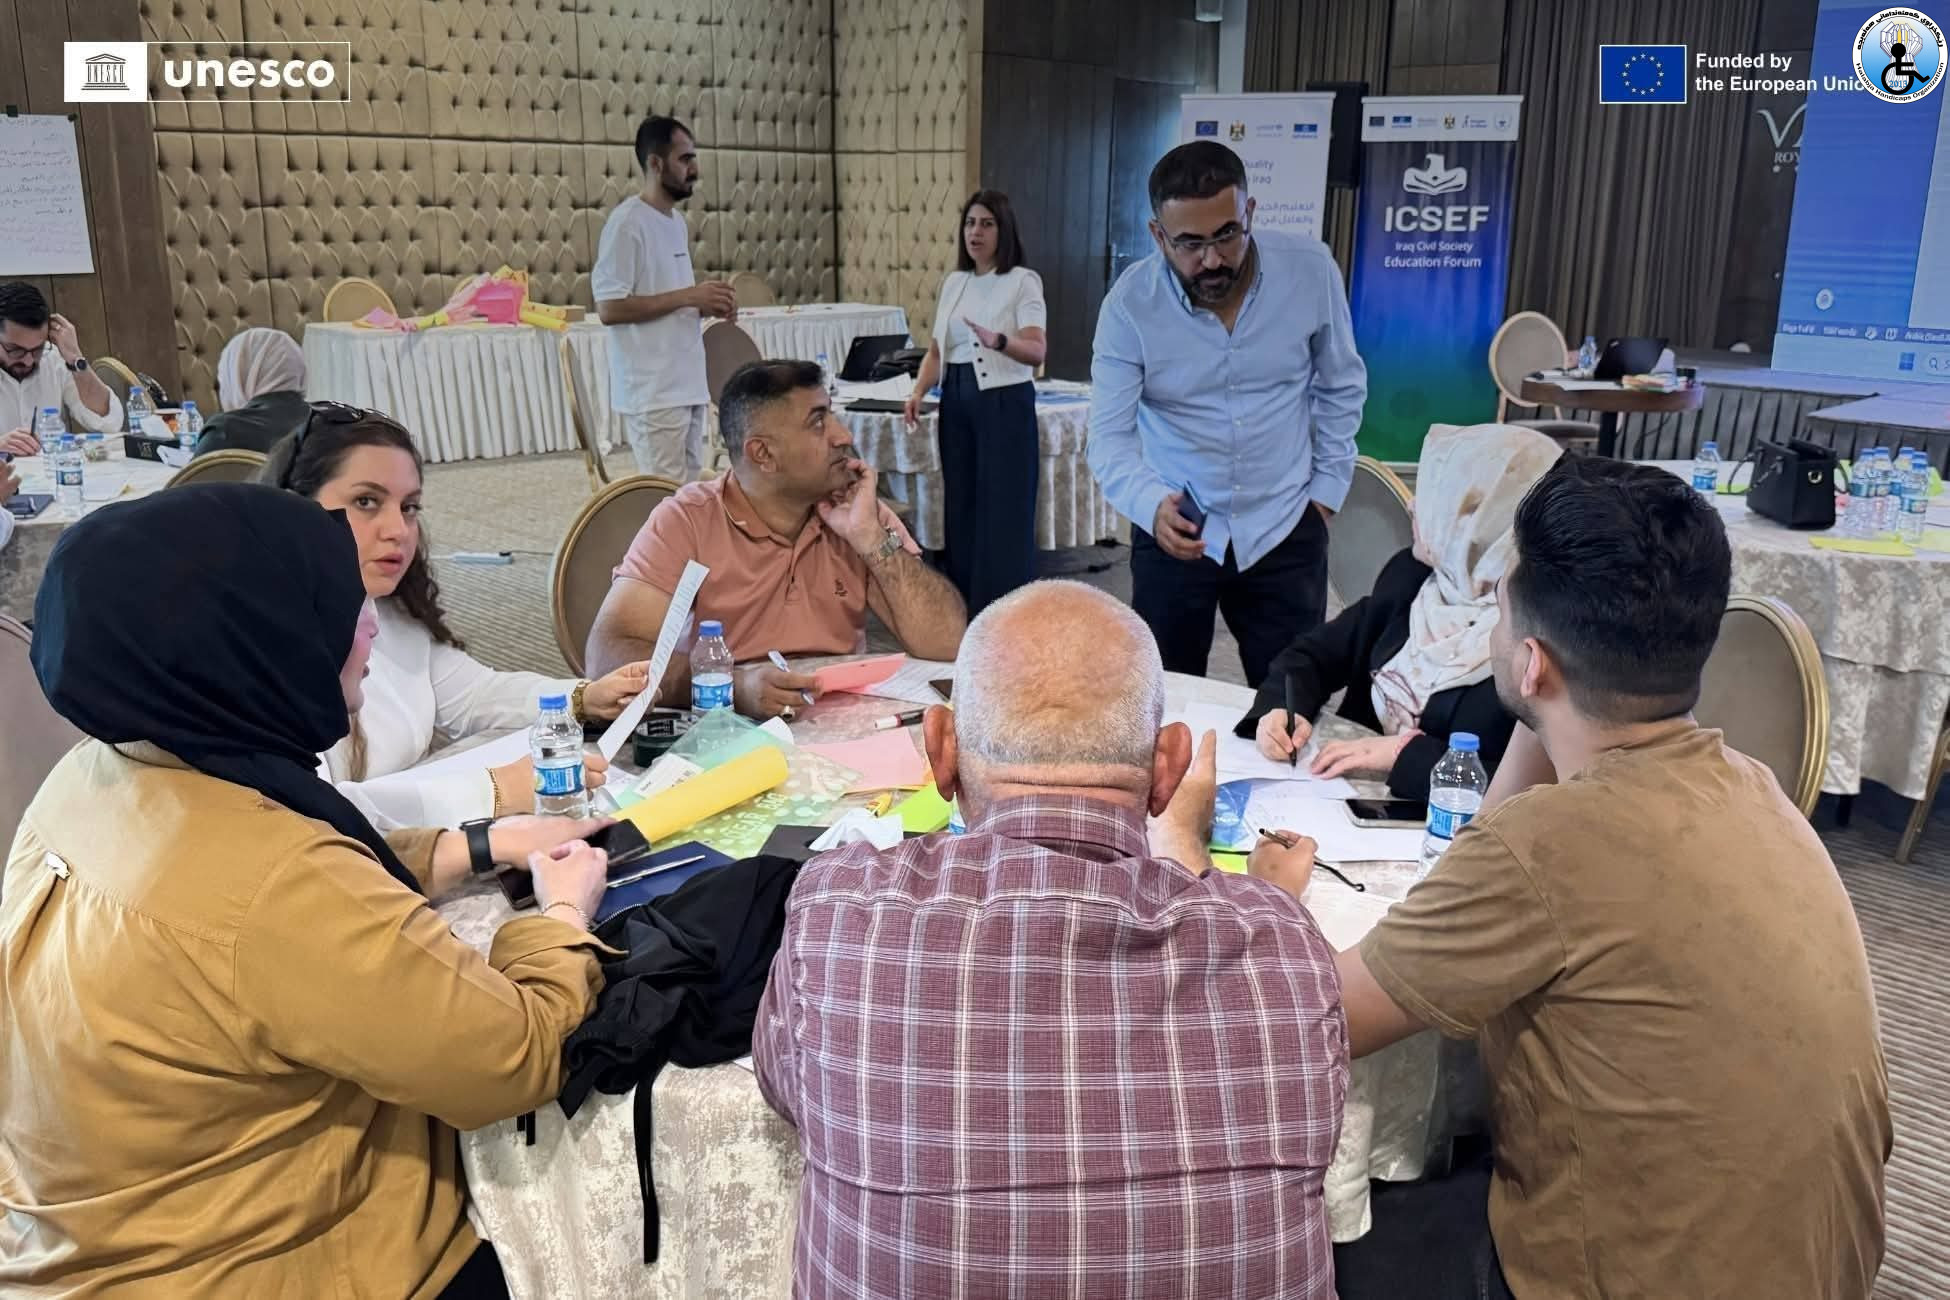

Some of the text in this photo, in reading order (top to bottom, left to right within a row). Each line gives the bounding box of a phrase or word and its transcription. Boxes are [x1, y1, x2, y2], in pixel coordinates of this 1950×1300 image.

[1244, 160, 1274, 172] uality
[1385, 206, 1490, 232] ICSEF
[1395, 241, 1474, 254] Iraq Civil Society
[1384, 256, 1482, 268] Education Forum
